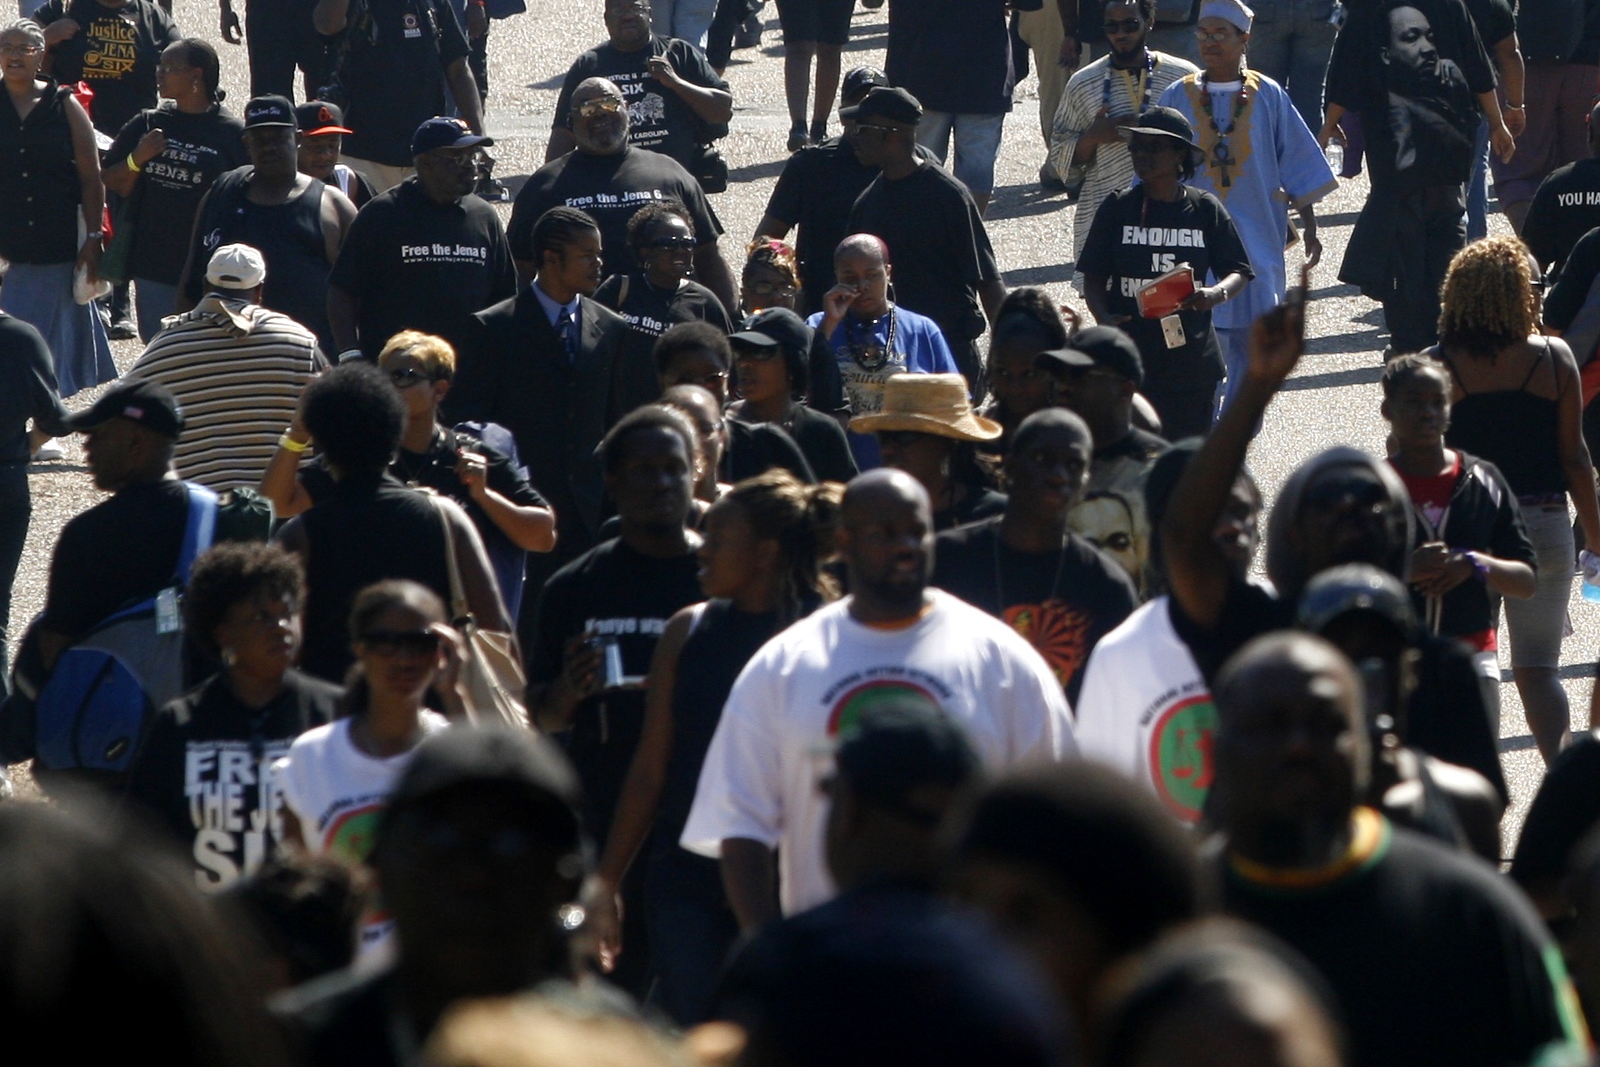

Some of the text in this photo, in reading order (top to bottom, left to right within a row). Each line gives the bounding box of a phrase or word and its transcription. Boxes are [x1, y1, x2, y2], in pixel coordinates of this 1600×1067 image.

[87, 21, 136, 41] Justice
[101, 42, 136, 59] JENA
[102, 60, 133, 73] SIX
[620, 82, 645, 95] SIX
[633, 129, 670, 141] CAROLINA
[565, 188, 663, 208] Free the Jena 6
[1558, 192, 1583, 207] YOU
[1121, 224, 1206, 248] ENOUGH
[401, 243, 487, 259] Free the Jena 6
[1151, 252, 1177, 273] IS
[641, 315, 663, 331] the
[185, 750, 287, 797] FRE
[192, 831, 266, 892] SI
